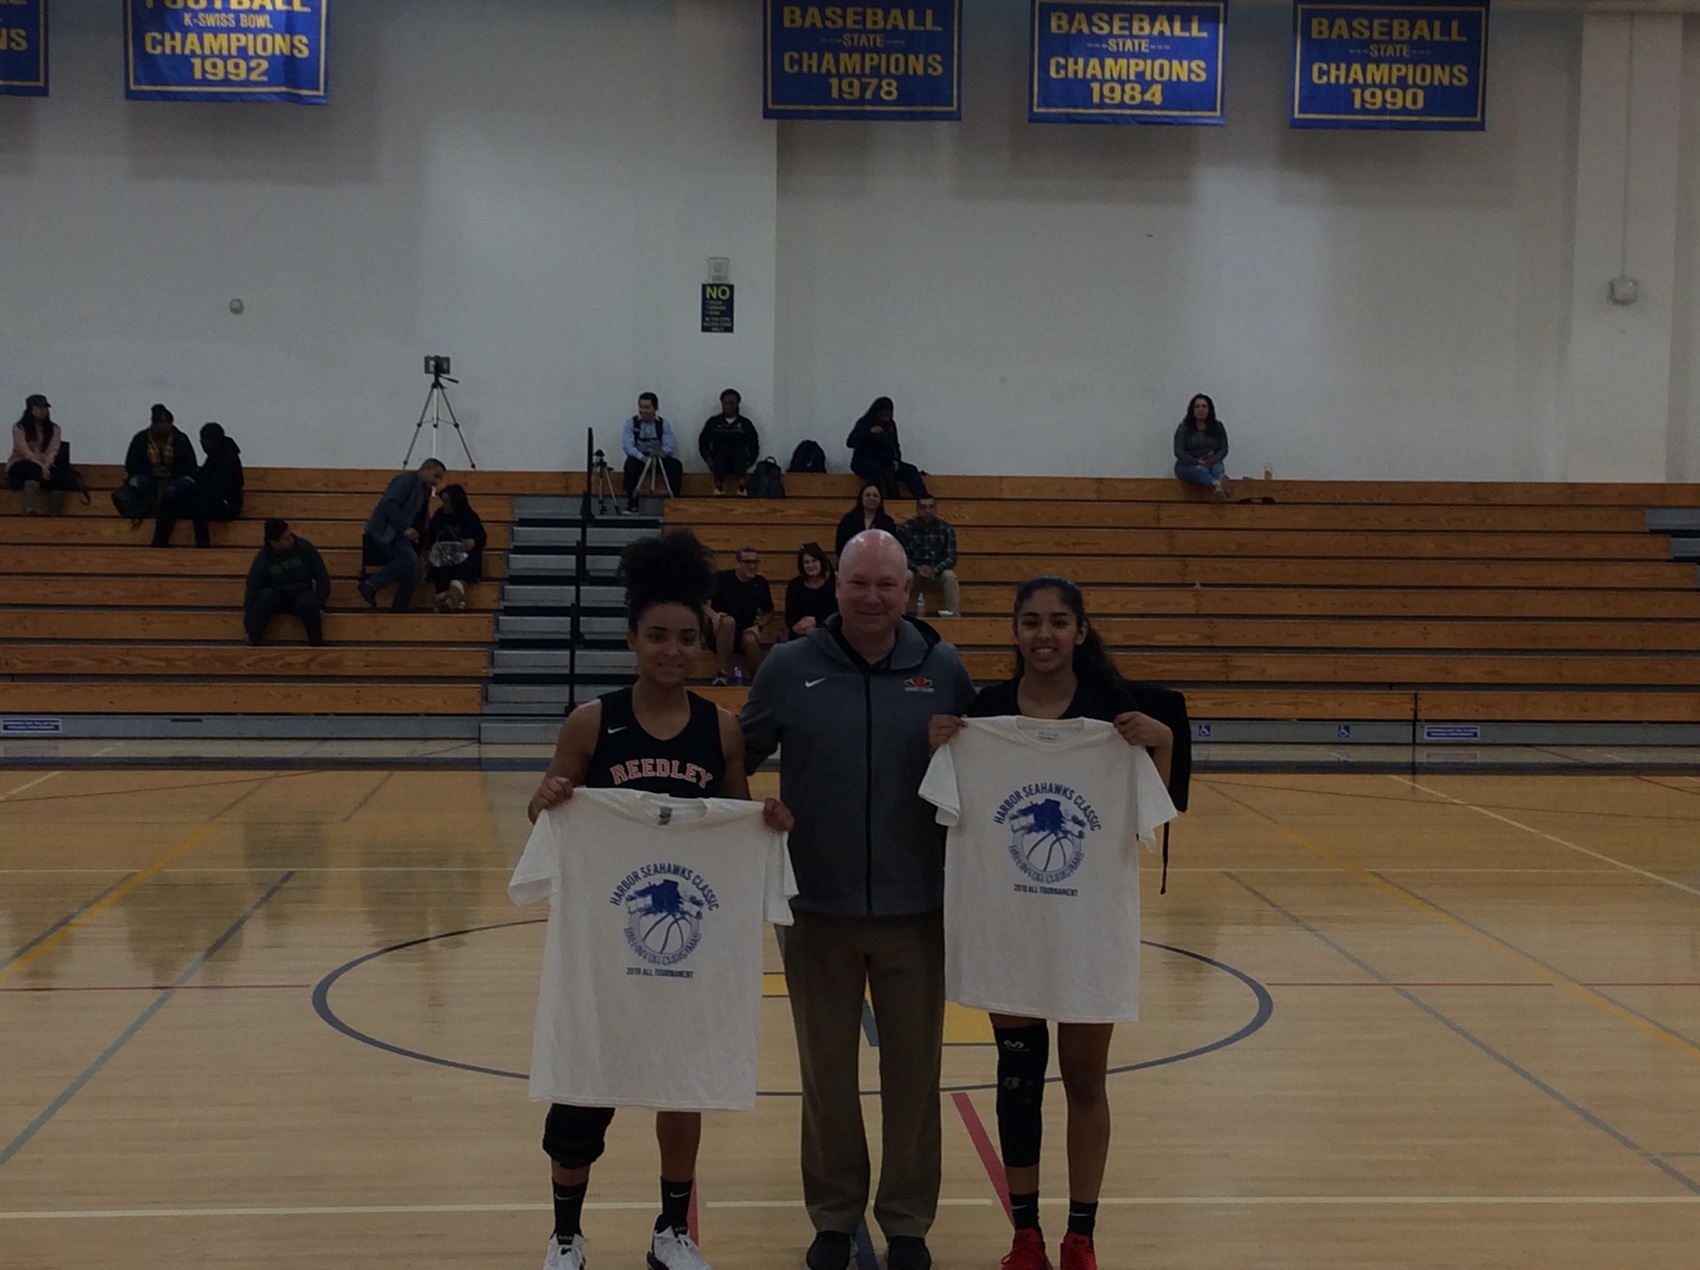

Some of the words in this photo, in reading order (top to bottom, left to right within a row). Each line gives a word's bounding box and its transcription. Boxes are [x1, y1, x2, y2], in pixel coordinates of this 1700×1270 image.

[183, 12, 236, 28] K-SWISS
[240, 13, 273, 29] BOWL
[783, 6, 943, 31] BASEBALL
[1050, 12, 1208, 37] BASEBALL
[1310, 17, 1468, 42] BASEBALL
[144, 31, 310, 59] CHAMPIONS
[842, 33, 885, 48] STATE
[1107, 38, 1150, 53] STATE
[1368, 43, 1411, 58] STATE
[190, 57, 269, 82] 1992
[783, 51, 944, 76] CHAMPIONS
[1049, 56, 1207, 82] CHAMPIONS
[1311, 62, 1469, 87] CHAMPIONS
[828, 77, 899, 101] 1978
[1090, 82, 1163, 106] 1984
[1351, 87, 1425, 110] 1990
[705, 285, 730, 300] NO
[609, 758, 714, 789] REEDLEY
[993, 790, 1024, 825] HARBOR
[1022, 782, 1076, 801] SEAHAWKS
[1073, 795, 1102, 832] CLASSIC
[609, 871, 642, 906] HARBOR
[640, 863, 694, 881] SEAHAWKS
[691, 874, 720, 911] CLASSIC
[1039, 886, 1079, 897] TOURNAMENT
[654, 968, 694, 979] TOURNAMENT
